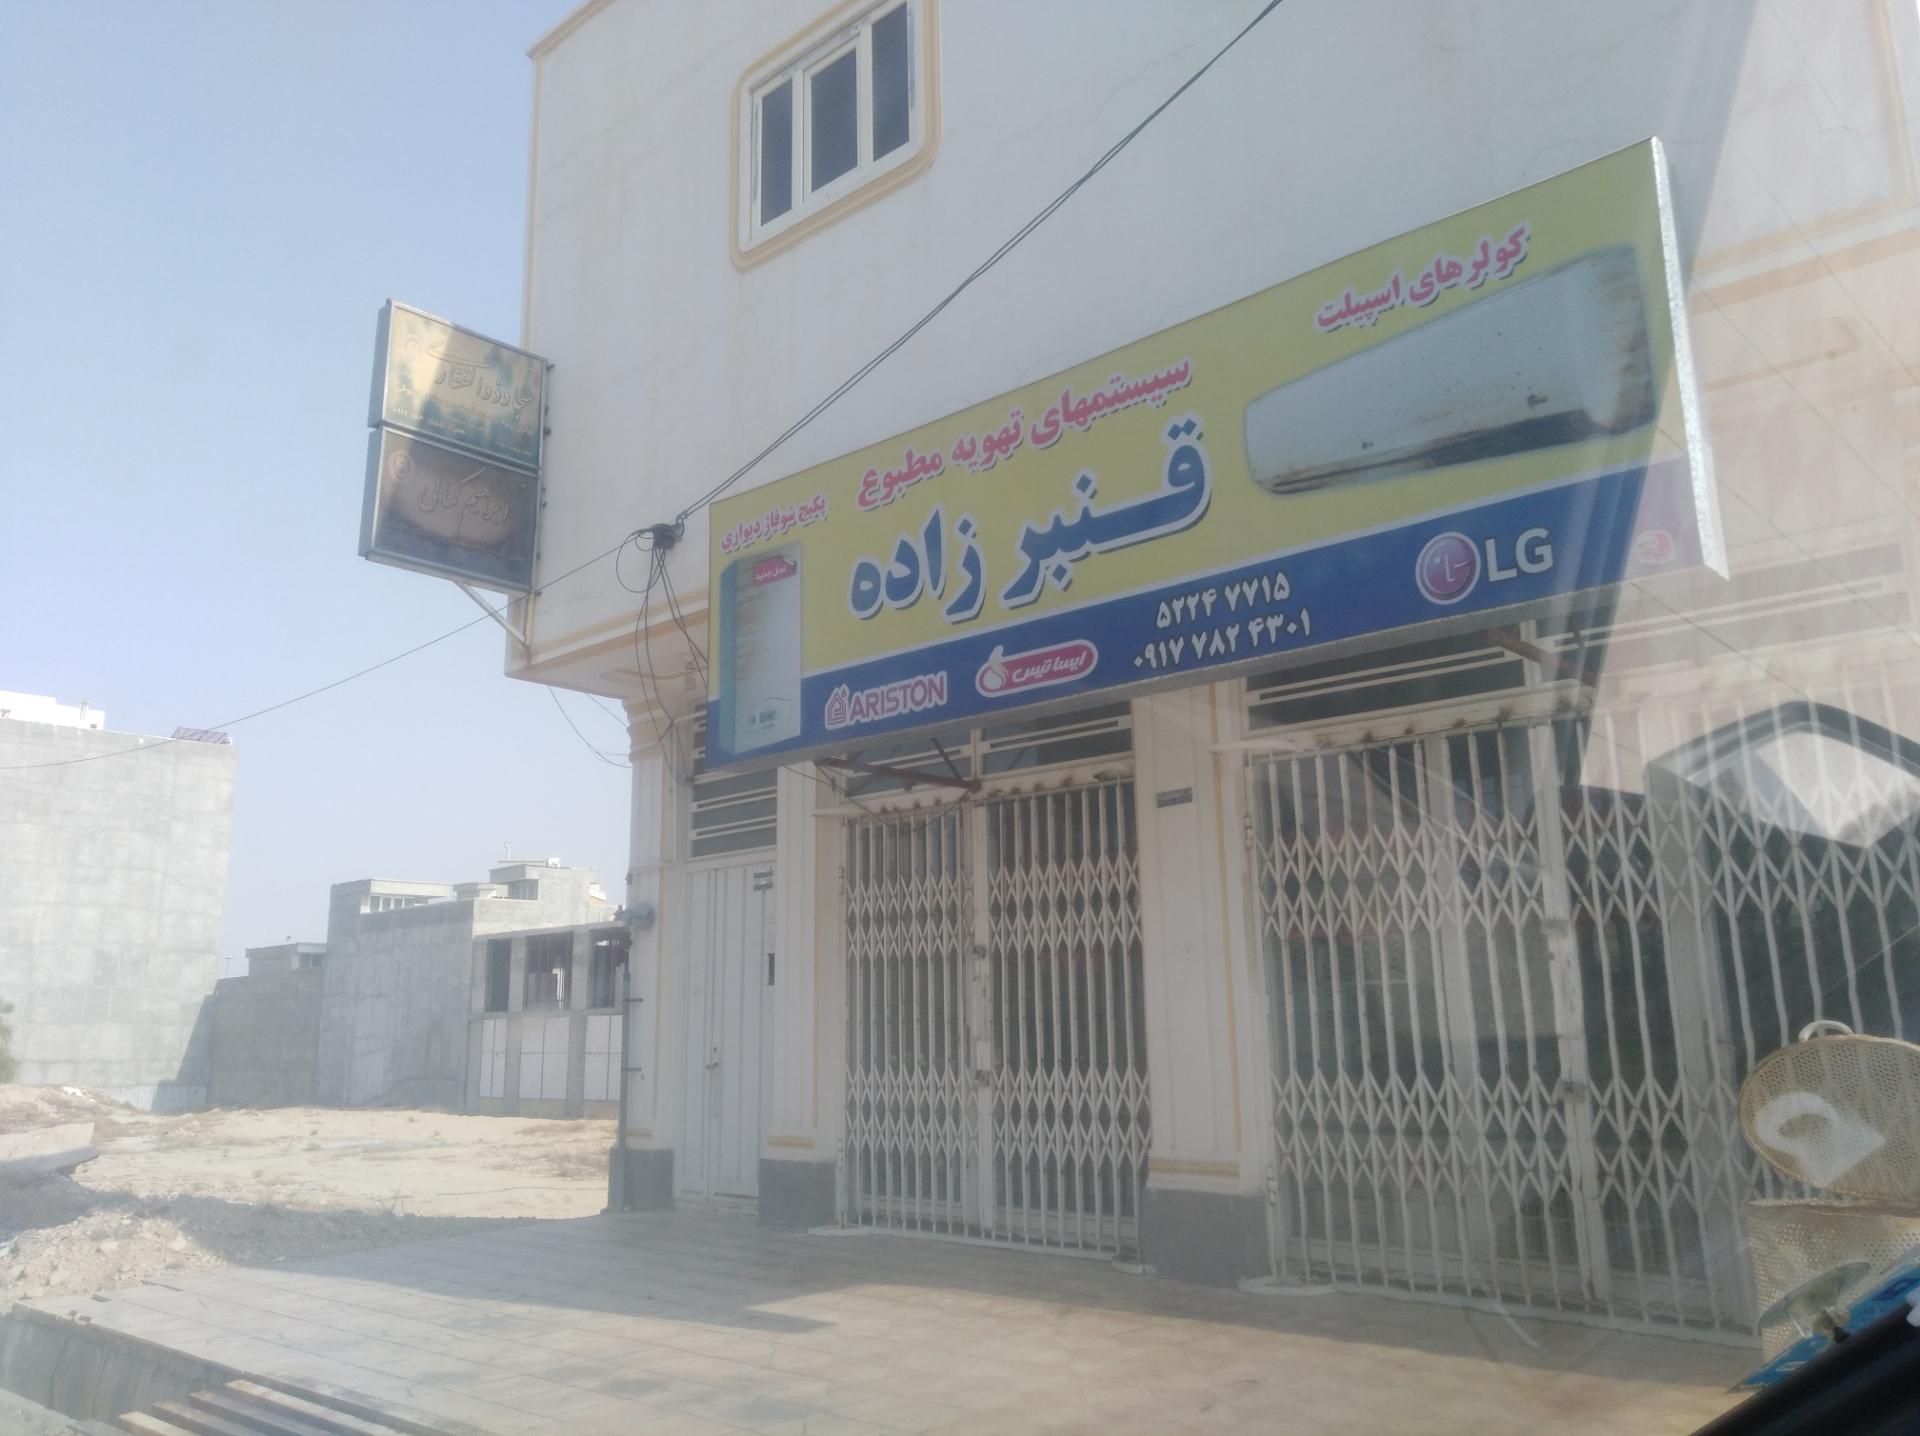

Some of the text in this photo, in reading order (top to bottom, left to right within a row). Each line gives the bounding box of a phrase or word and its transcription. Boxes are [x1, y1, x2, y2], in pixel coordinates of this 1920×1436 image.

[1317, 227, 1526, 327] کولرهای اسپیلت
[857, 359, 1189, 507] سیستمهای تهویه مطبوع
[721, 520, 761, 551] دیواری
[799, 494, 826, 523] پکیج
[851, 418, 1206, 616] قنبر زاده
[1485, 527, 1554, 582] LG
[1224, 571, 1290, 612] ۷۷۱۵
[1133, 607, 1311, 669] ۰۹۱۷ ۷۸۲ ۴۳۰۱
[850, 674, 946, 722] ARISTON
